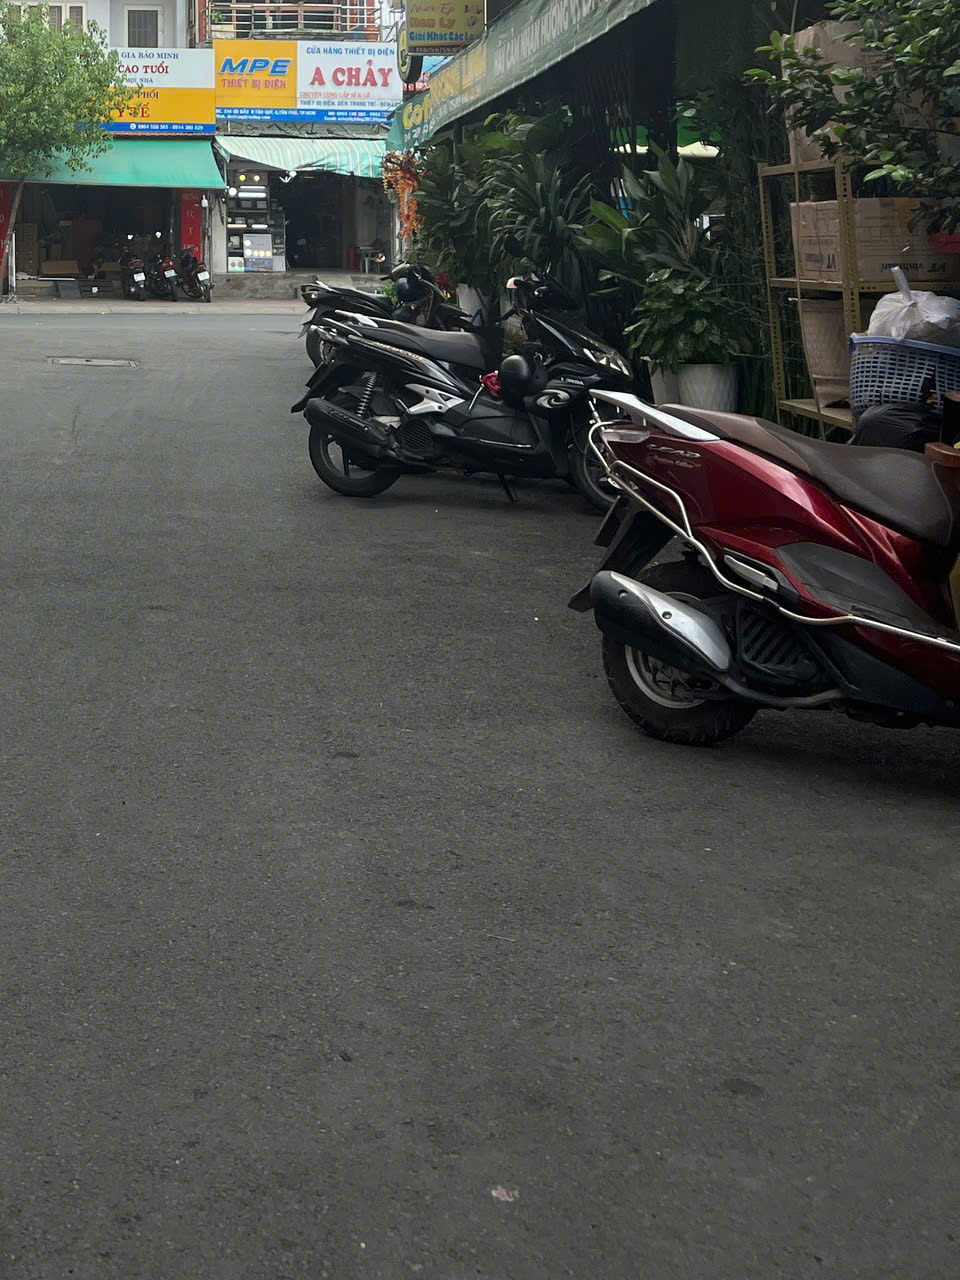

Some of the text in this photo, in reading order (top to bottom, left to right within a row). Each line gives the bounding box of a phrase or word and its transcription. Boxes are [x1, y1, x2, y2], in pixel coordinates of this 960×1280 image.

[138, 50, 154, 59] BẢO
[306, 46, 395, 58] CỬA HÀNG THIẾT BỊ ĐIỆN
[118, 61, 169, 74] CAO TUỔI
[219, 58, 292, 76] MPE
[309, 59, 393, 87] A CHẢY
[221, 77, 286, 91] THIẾT BỊ ĐIỆN
[137, 87, 159, 99] PHỐI
